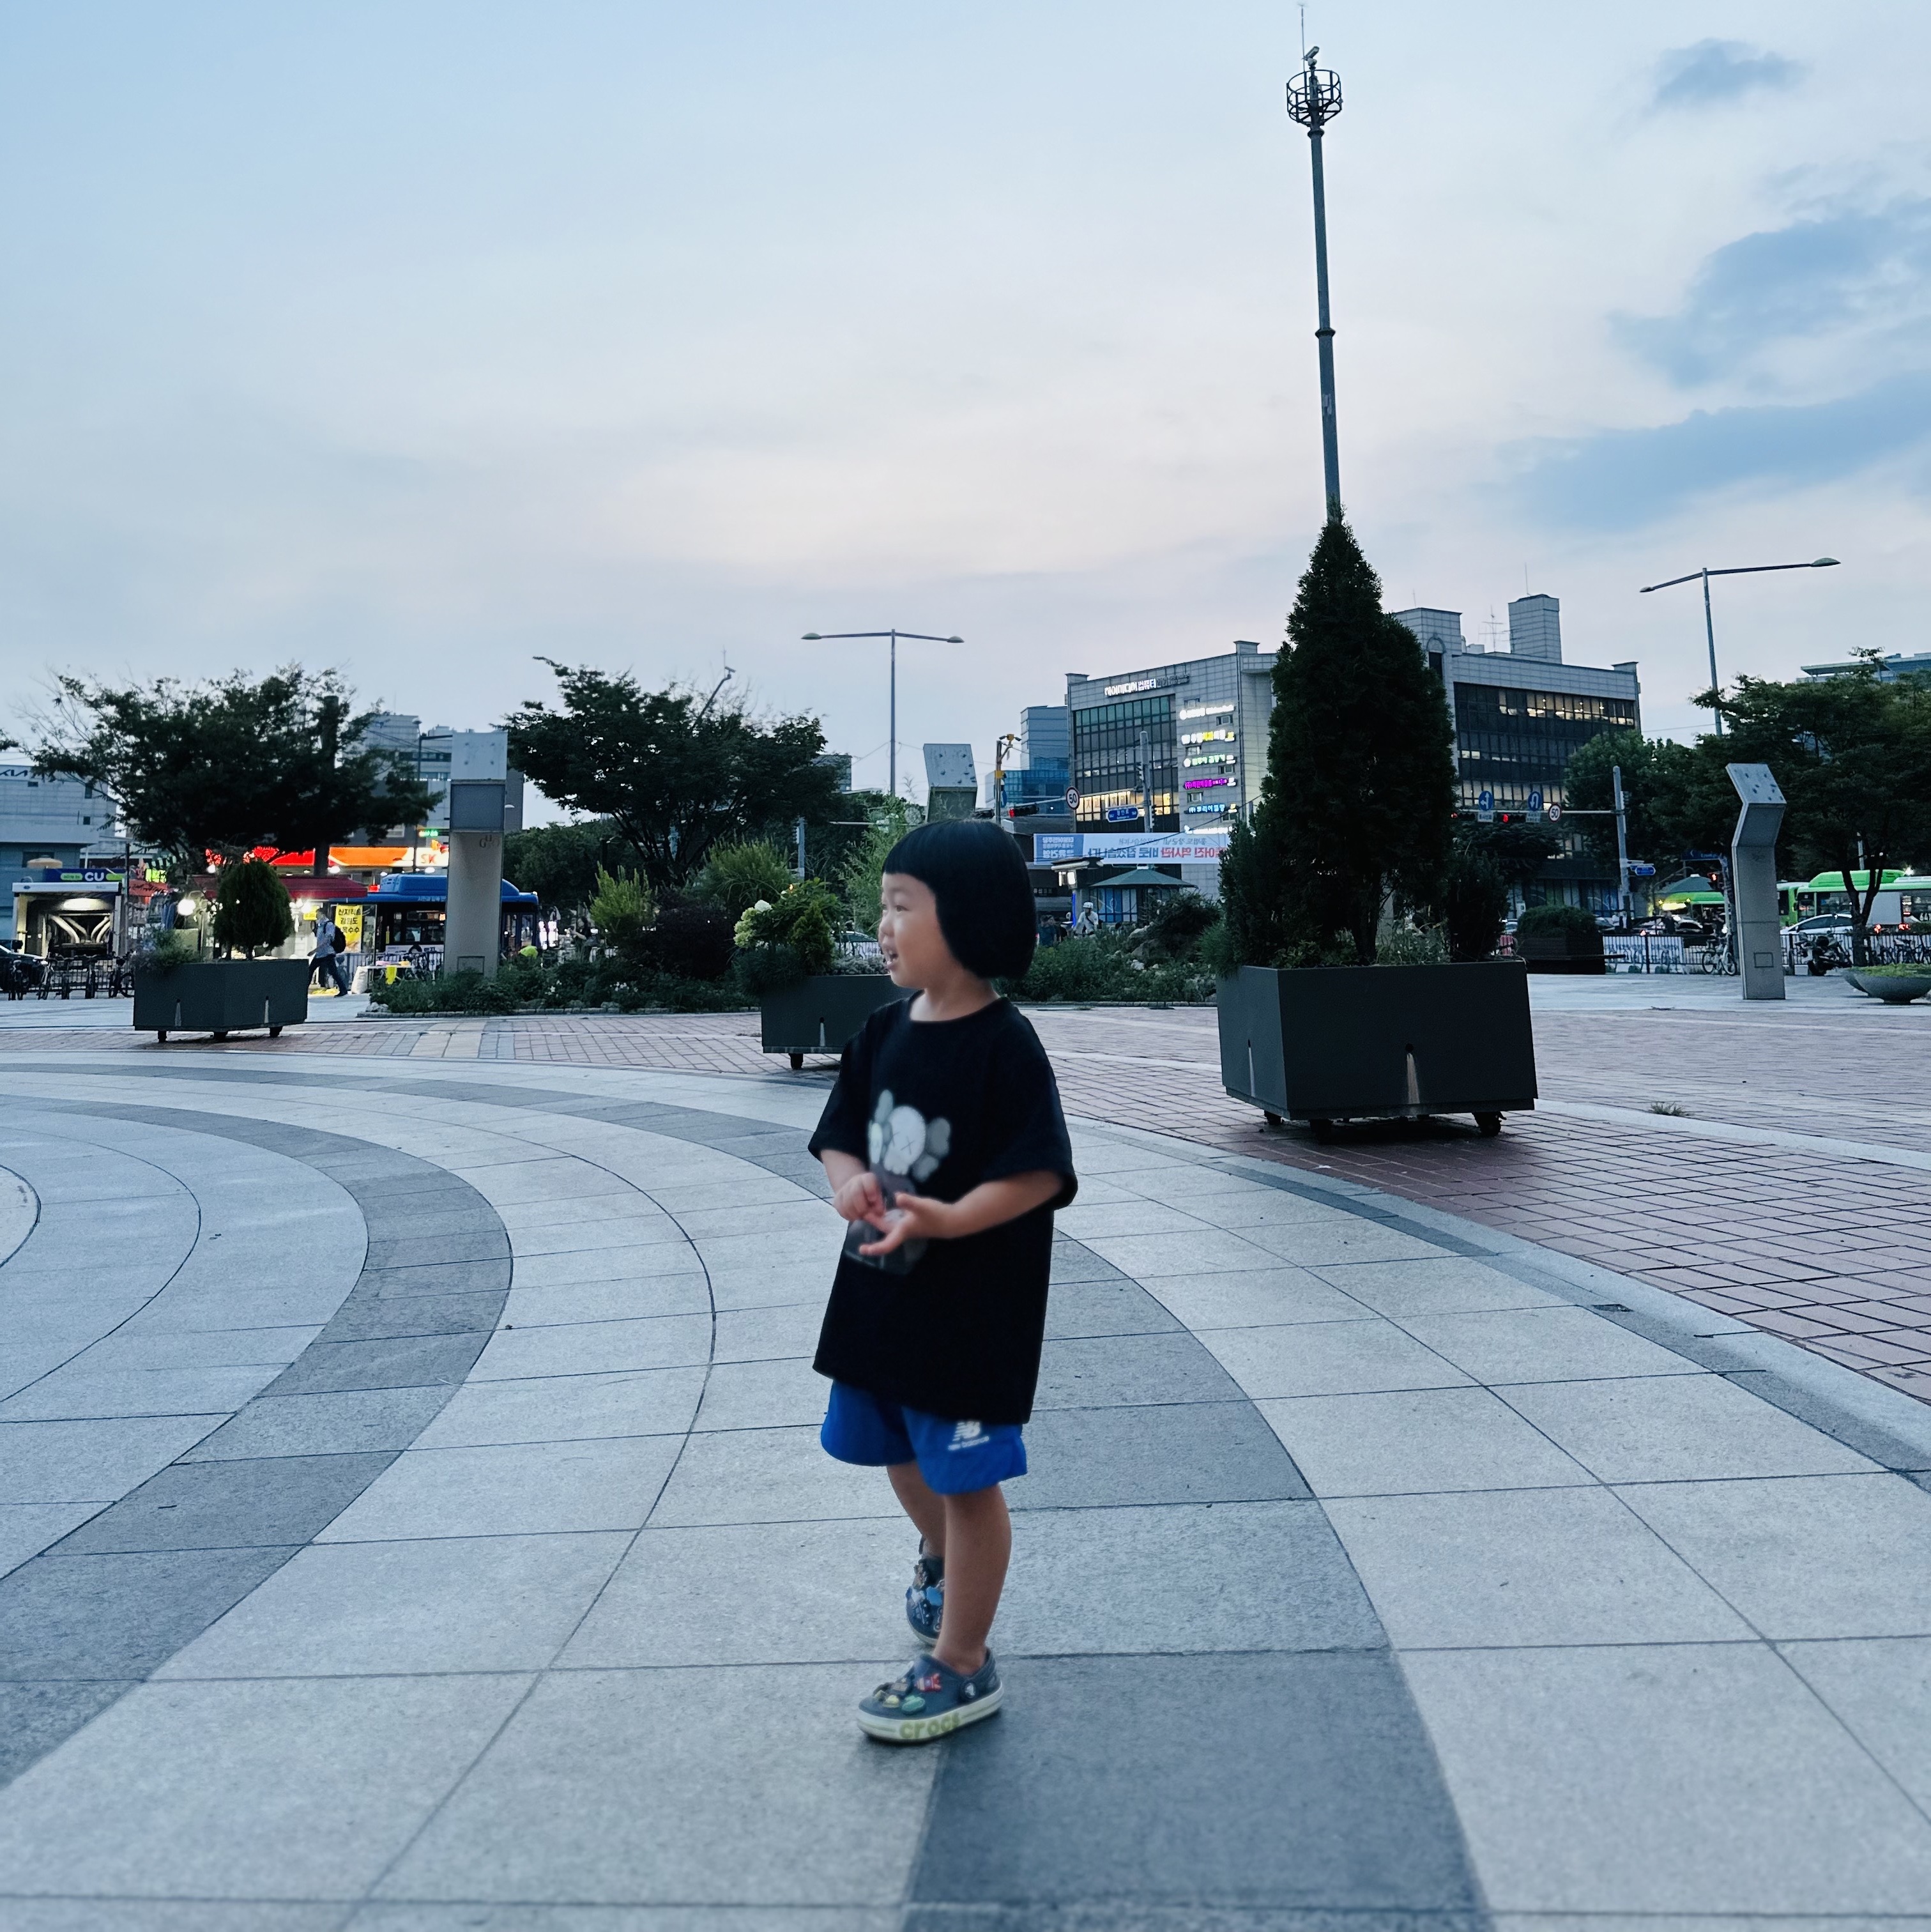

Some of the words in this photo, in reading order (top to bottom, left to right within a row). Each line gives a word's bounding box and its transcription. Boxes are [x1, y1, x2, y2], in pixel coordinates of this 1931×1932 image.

[1069, 793, 1077, 804] 50
[1551, 808, 1559, 818] 50
[420, 854, 437, 864] SK
[84, 871, 105, 882] CU
[899, 1712, 961, 1739] crocs
